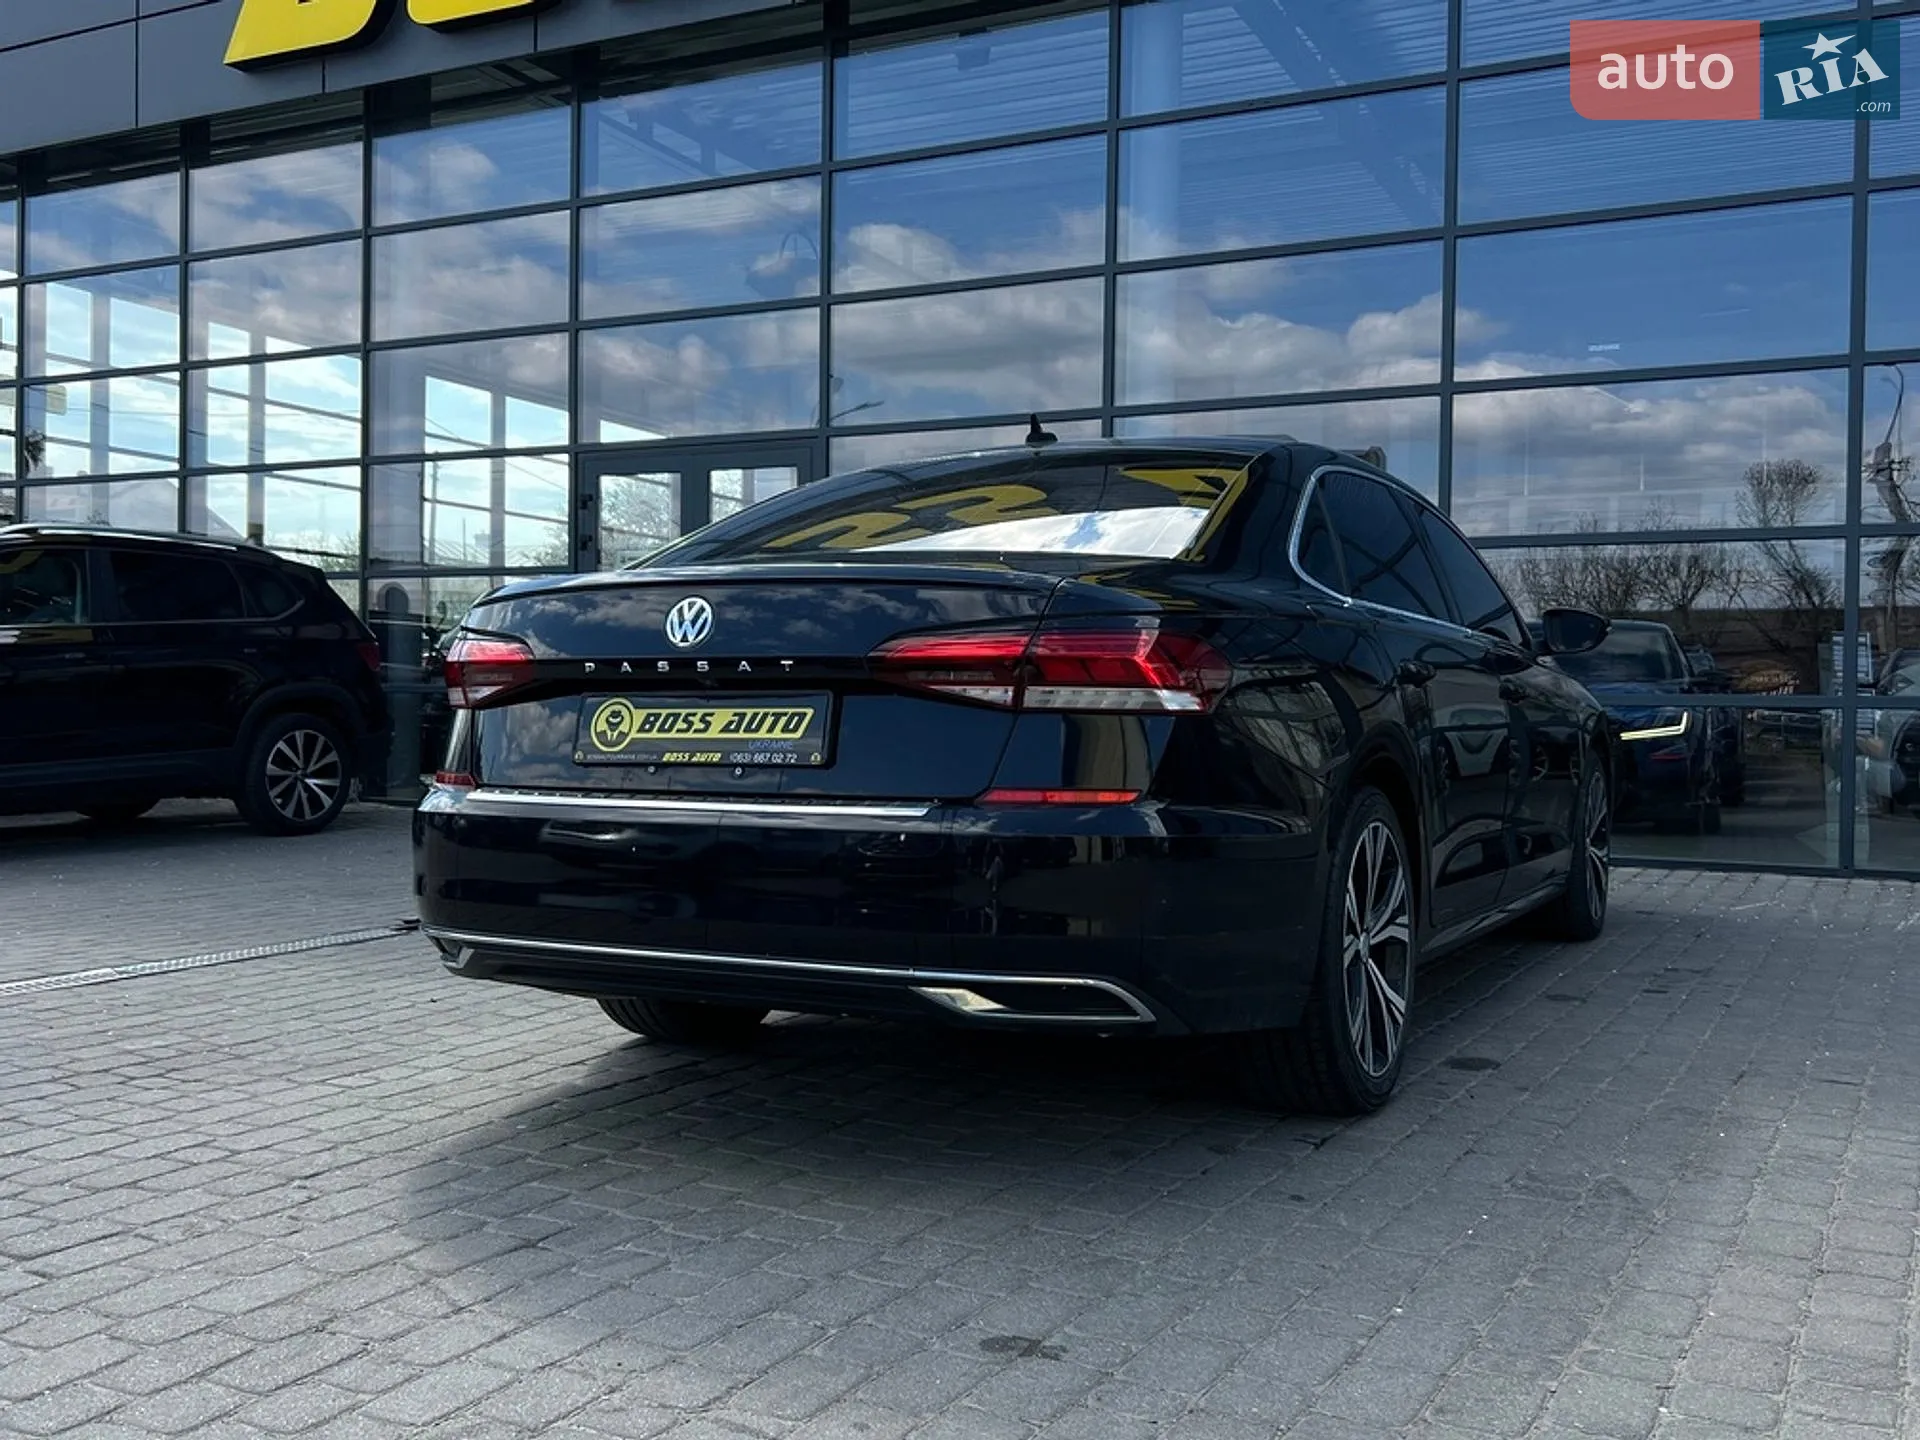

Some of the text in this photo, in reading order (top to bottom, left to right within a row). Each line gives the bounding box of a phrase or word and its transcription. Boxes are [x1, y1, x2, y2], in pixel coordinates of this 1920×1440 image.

[584, 660, 794, 673] PASSAT
[636, 711, 808, 734] BOSS AUTO
[748, 740, 794, 750] UKRAINE
[662, 752, 722, 762] BOSS AUTO
[785, 752, 798, 763] 72
